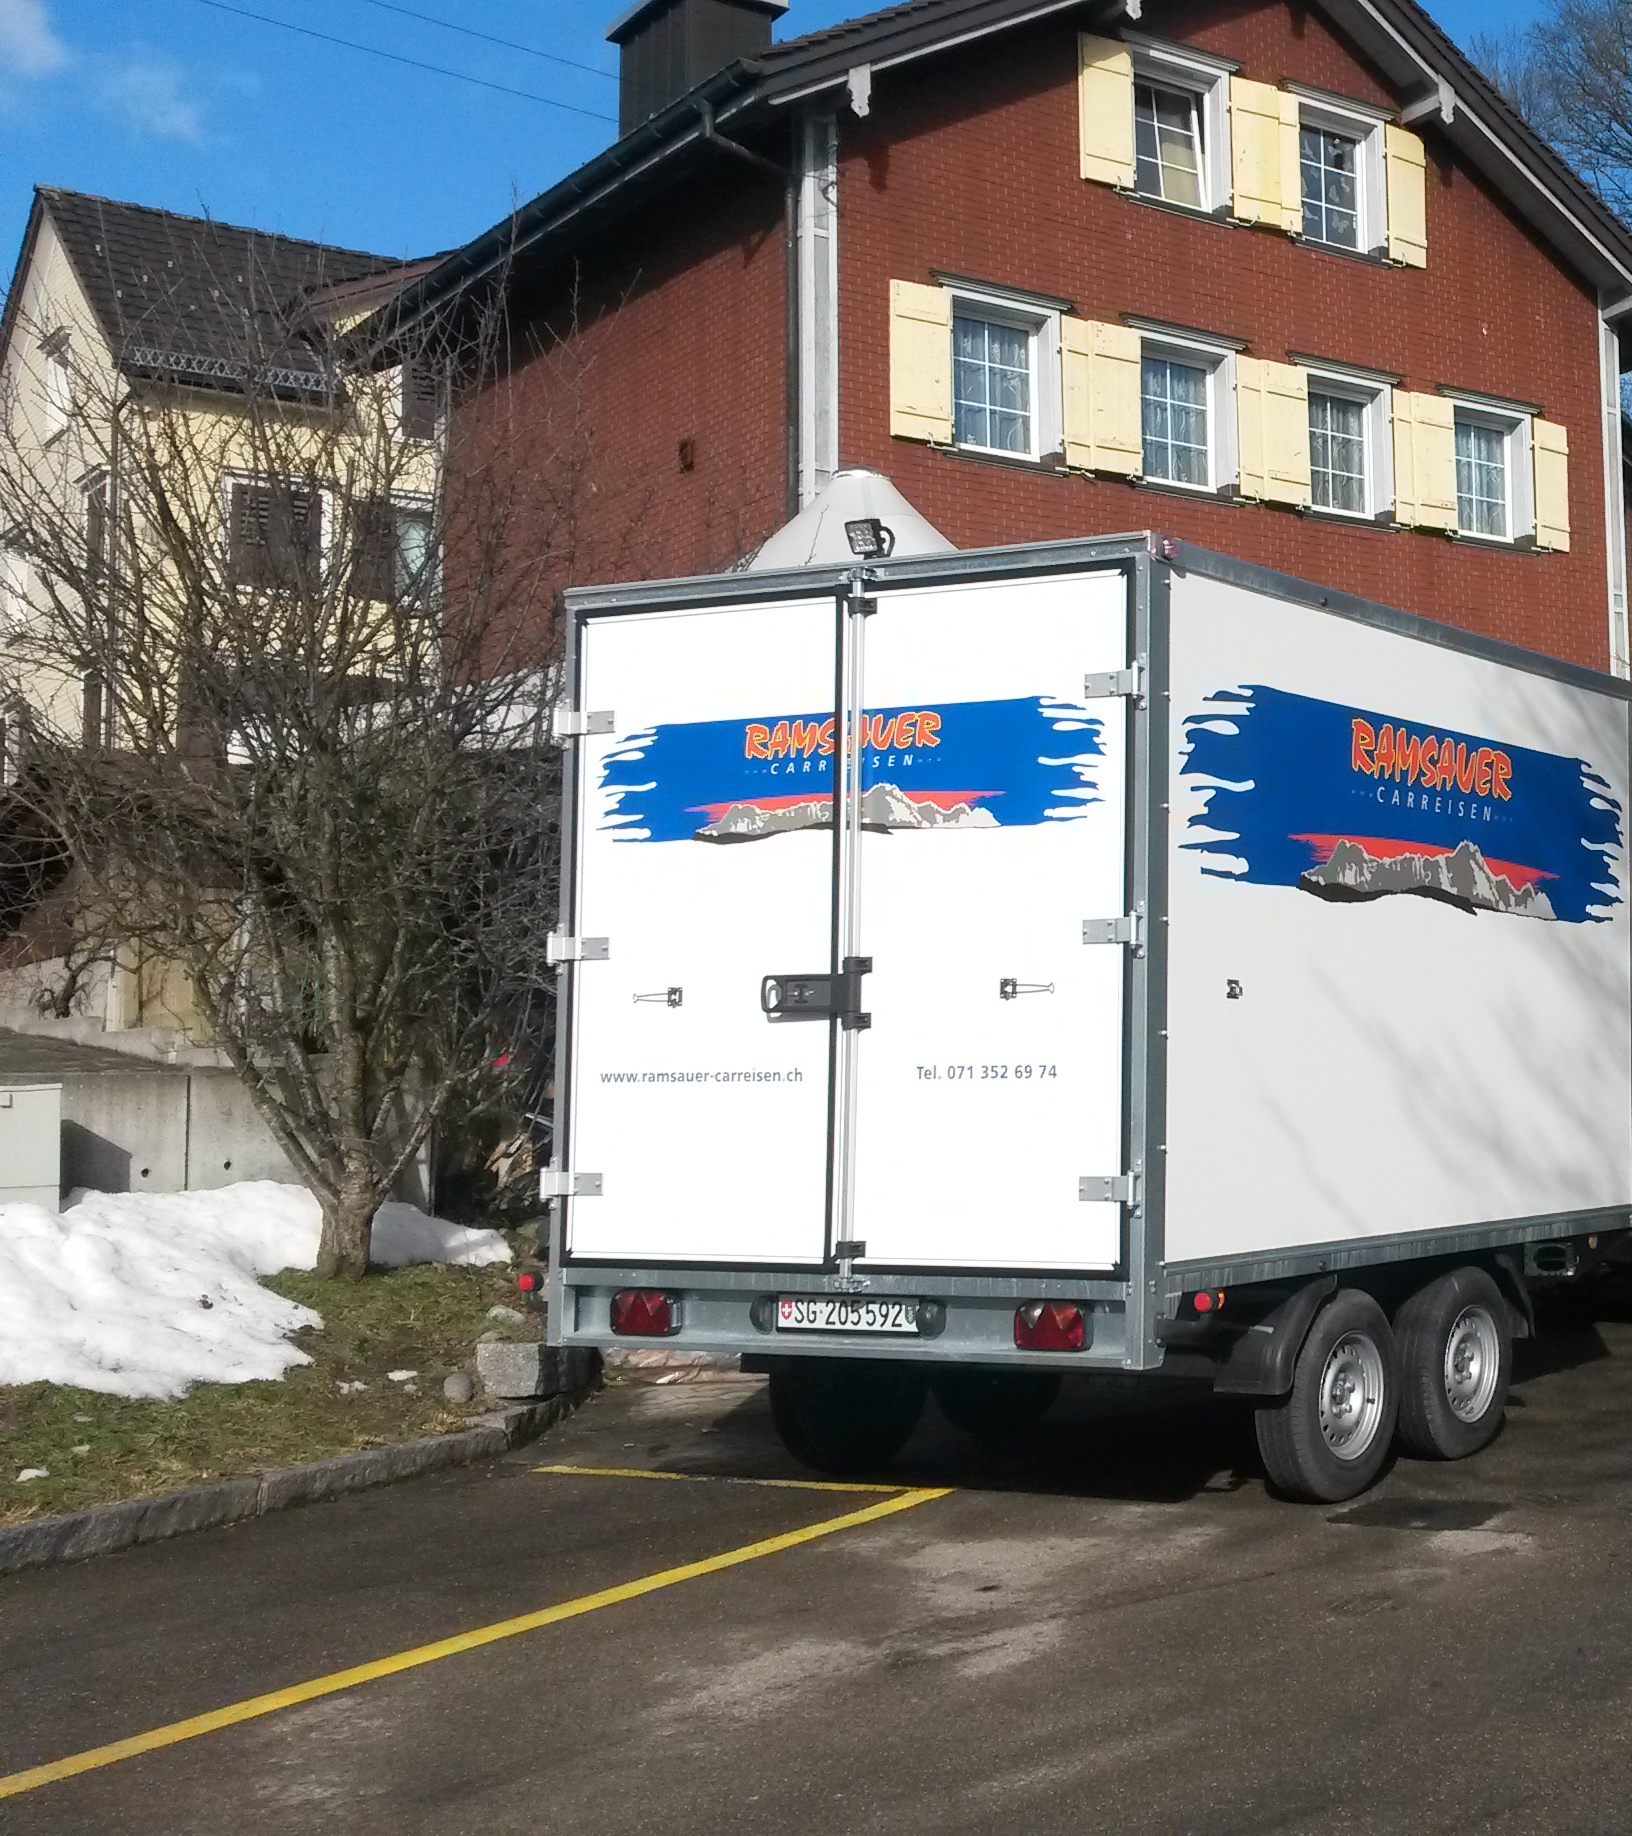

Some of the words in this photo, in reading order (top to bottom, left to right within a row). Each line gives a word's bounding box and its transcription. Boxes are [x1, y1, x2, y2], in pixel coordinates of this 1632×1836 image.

[770, 754, 914, 775] CARRSEN
[1352, 718, 1512, 801] RAMSAUER
[1376, 786, 1492, 822] CARREISEN
[600, 1067, 803, 1083] www.ramsauer-carreisen.ch
[916, 1065, 942, 1080] Tel.
[947, 1065, 974, 1080] 071
[980, 1065, 1008, 1079] 352
[1014, 1064, 1033, 1079] 69
[1038, 1064, 1058, 1079] 74
